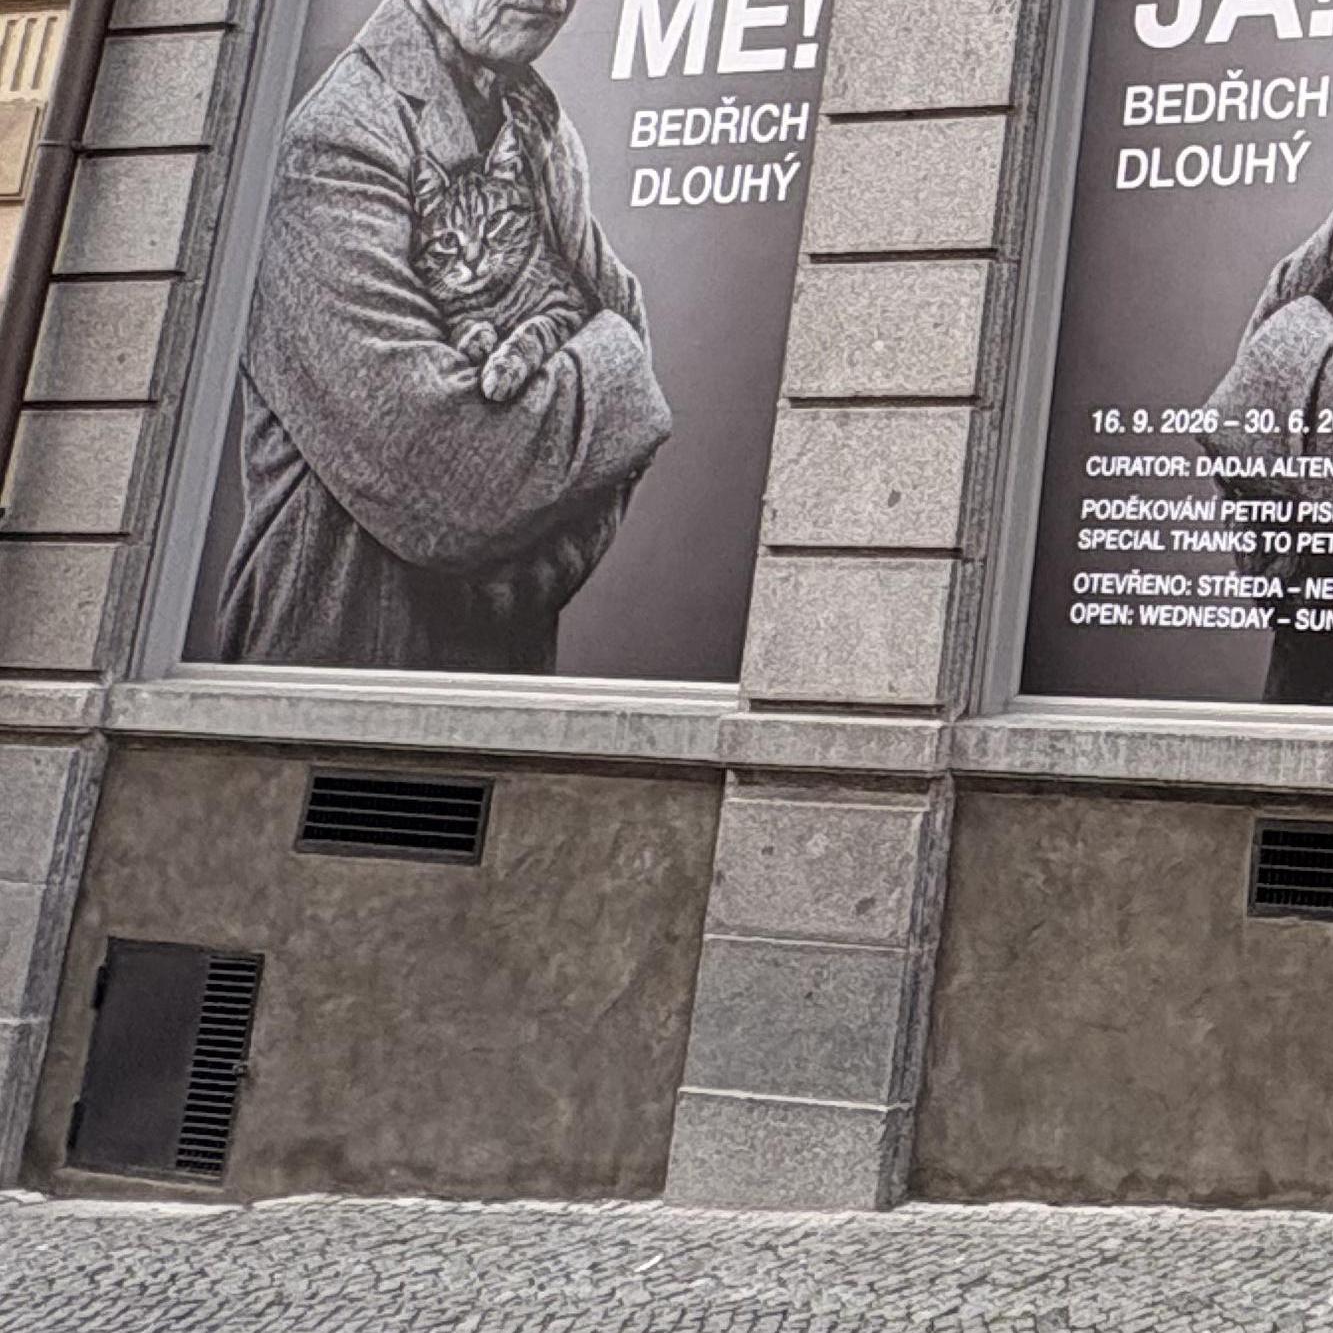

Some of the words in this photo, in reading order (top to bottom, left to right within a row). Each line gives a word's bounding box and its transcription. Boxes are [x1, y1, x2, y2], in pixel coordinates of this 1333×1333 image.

[1123, 69, 1330, 126] BEDŘICH
[629, 96, 810, 148] BEDŘICH
[1116, 129, 1312, 189] DLOUHÝ
[629, 151, 801, 207] DLOUHÝ
[1092, 409, 1126, 434] 16.
[1132, 409, 1154, 434] 9.
[1160, 408, 1219, 434] 2026
[1244, 408, 1281, 434] 30.
[1288, 409, 1310, 434] 6.
[1085, 455, 1191, 478] CURATOR:
[1195, 455, 1268, 478] DADJA
[1080, 494, 1218, 520] PODĚKOVÁNÍ
[1221, 500, 1293, 523] PETRU
[1077, 528, 1166, 551] SPECIAL
[1170, 529, 1257, 553] THANKS
[1261, 531, 1292, 553] TO
[1073, 568, 1192, 596] OTEVŘENO:
[1197, 570, 1284, 599] STŘEDA
[1070, 602, 1133, 626] OPEN:
[1139, 604, 1275, 629] WEDNESDAY
